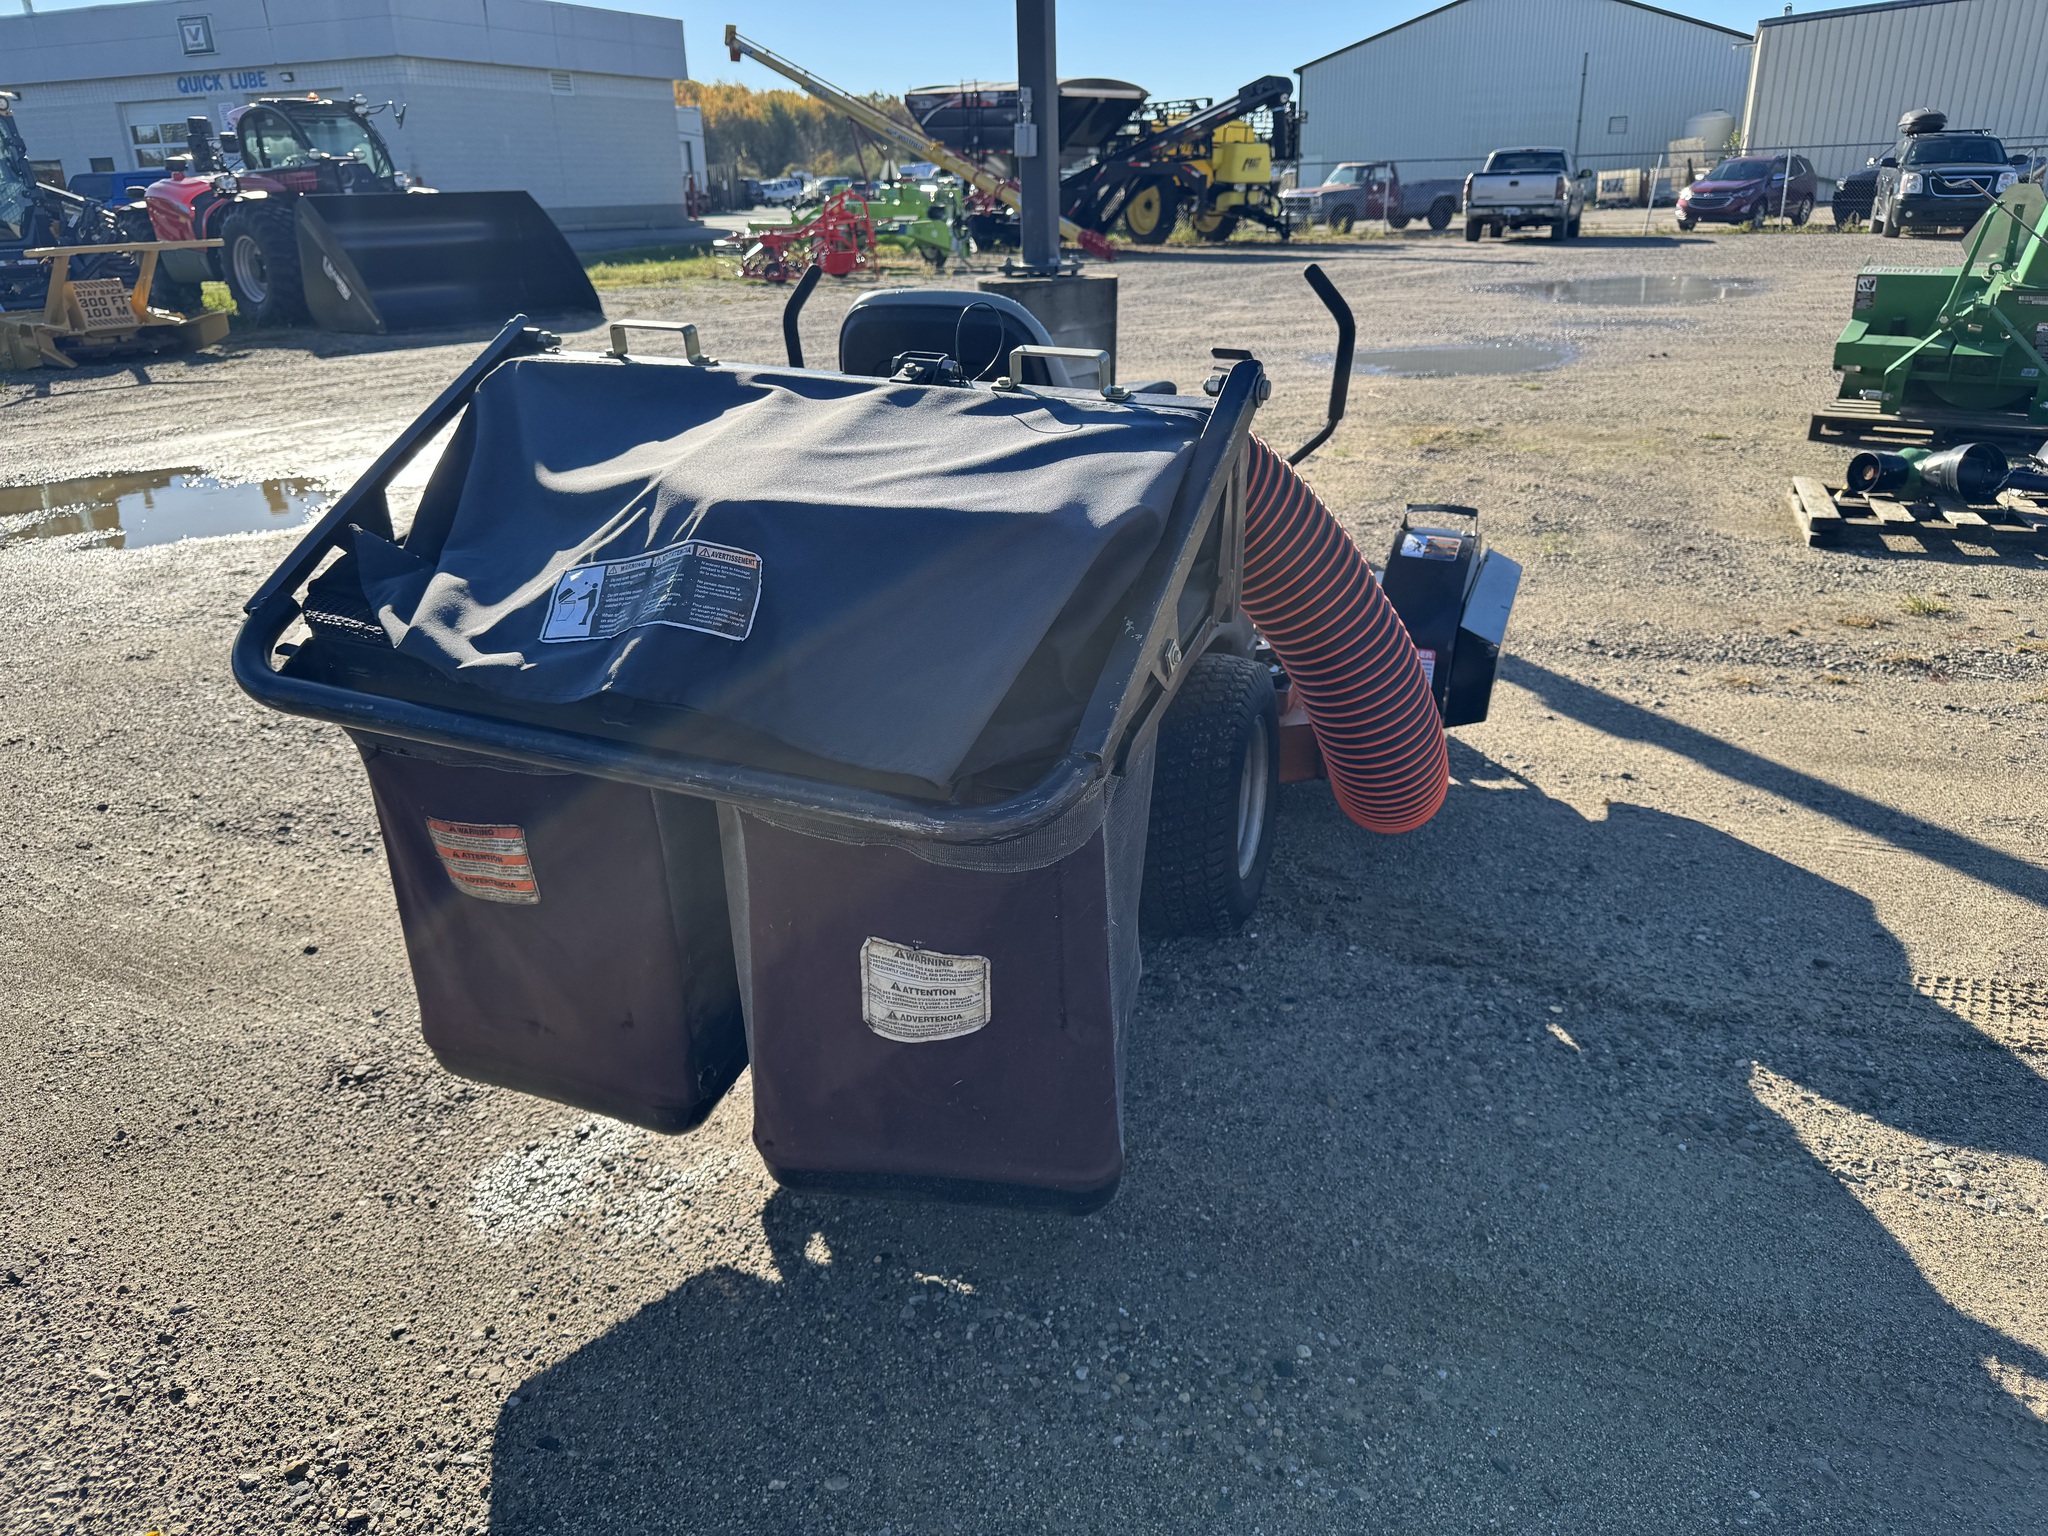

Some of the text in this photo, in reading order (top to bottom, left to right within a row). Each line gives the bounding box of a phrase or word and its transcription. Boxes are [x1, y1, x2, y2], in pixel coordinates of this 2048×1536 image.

[177, 71, 268, 94] QUICK LUBE
[76, 288, 122, 298] STAY BACK
[79, 295, 126, 308] 300 FT
[85, 306, 129, 318] 100 M
[711, 551, 755, 566] AVERTISSEMENT
[620, 561, 647, 572] WARNING
[457, 828, 494, 836] WARNING
[462, 851, 503, 862] ATTENTION
[465, 876, 516, 888] ADVERTENCIA
[906, 951, 953, 967] WARNING
[903, 986, 956, 996] ATTENTION
[900, 1013, 963, 1023] ADVERTENCIA
